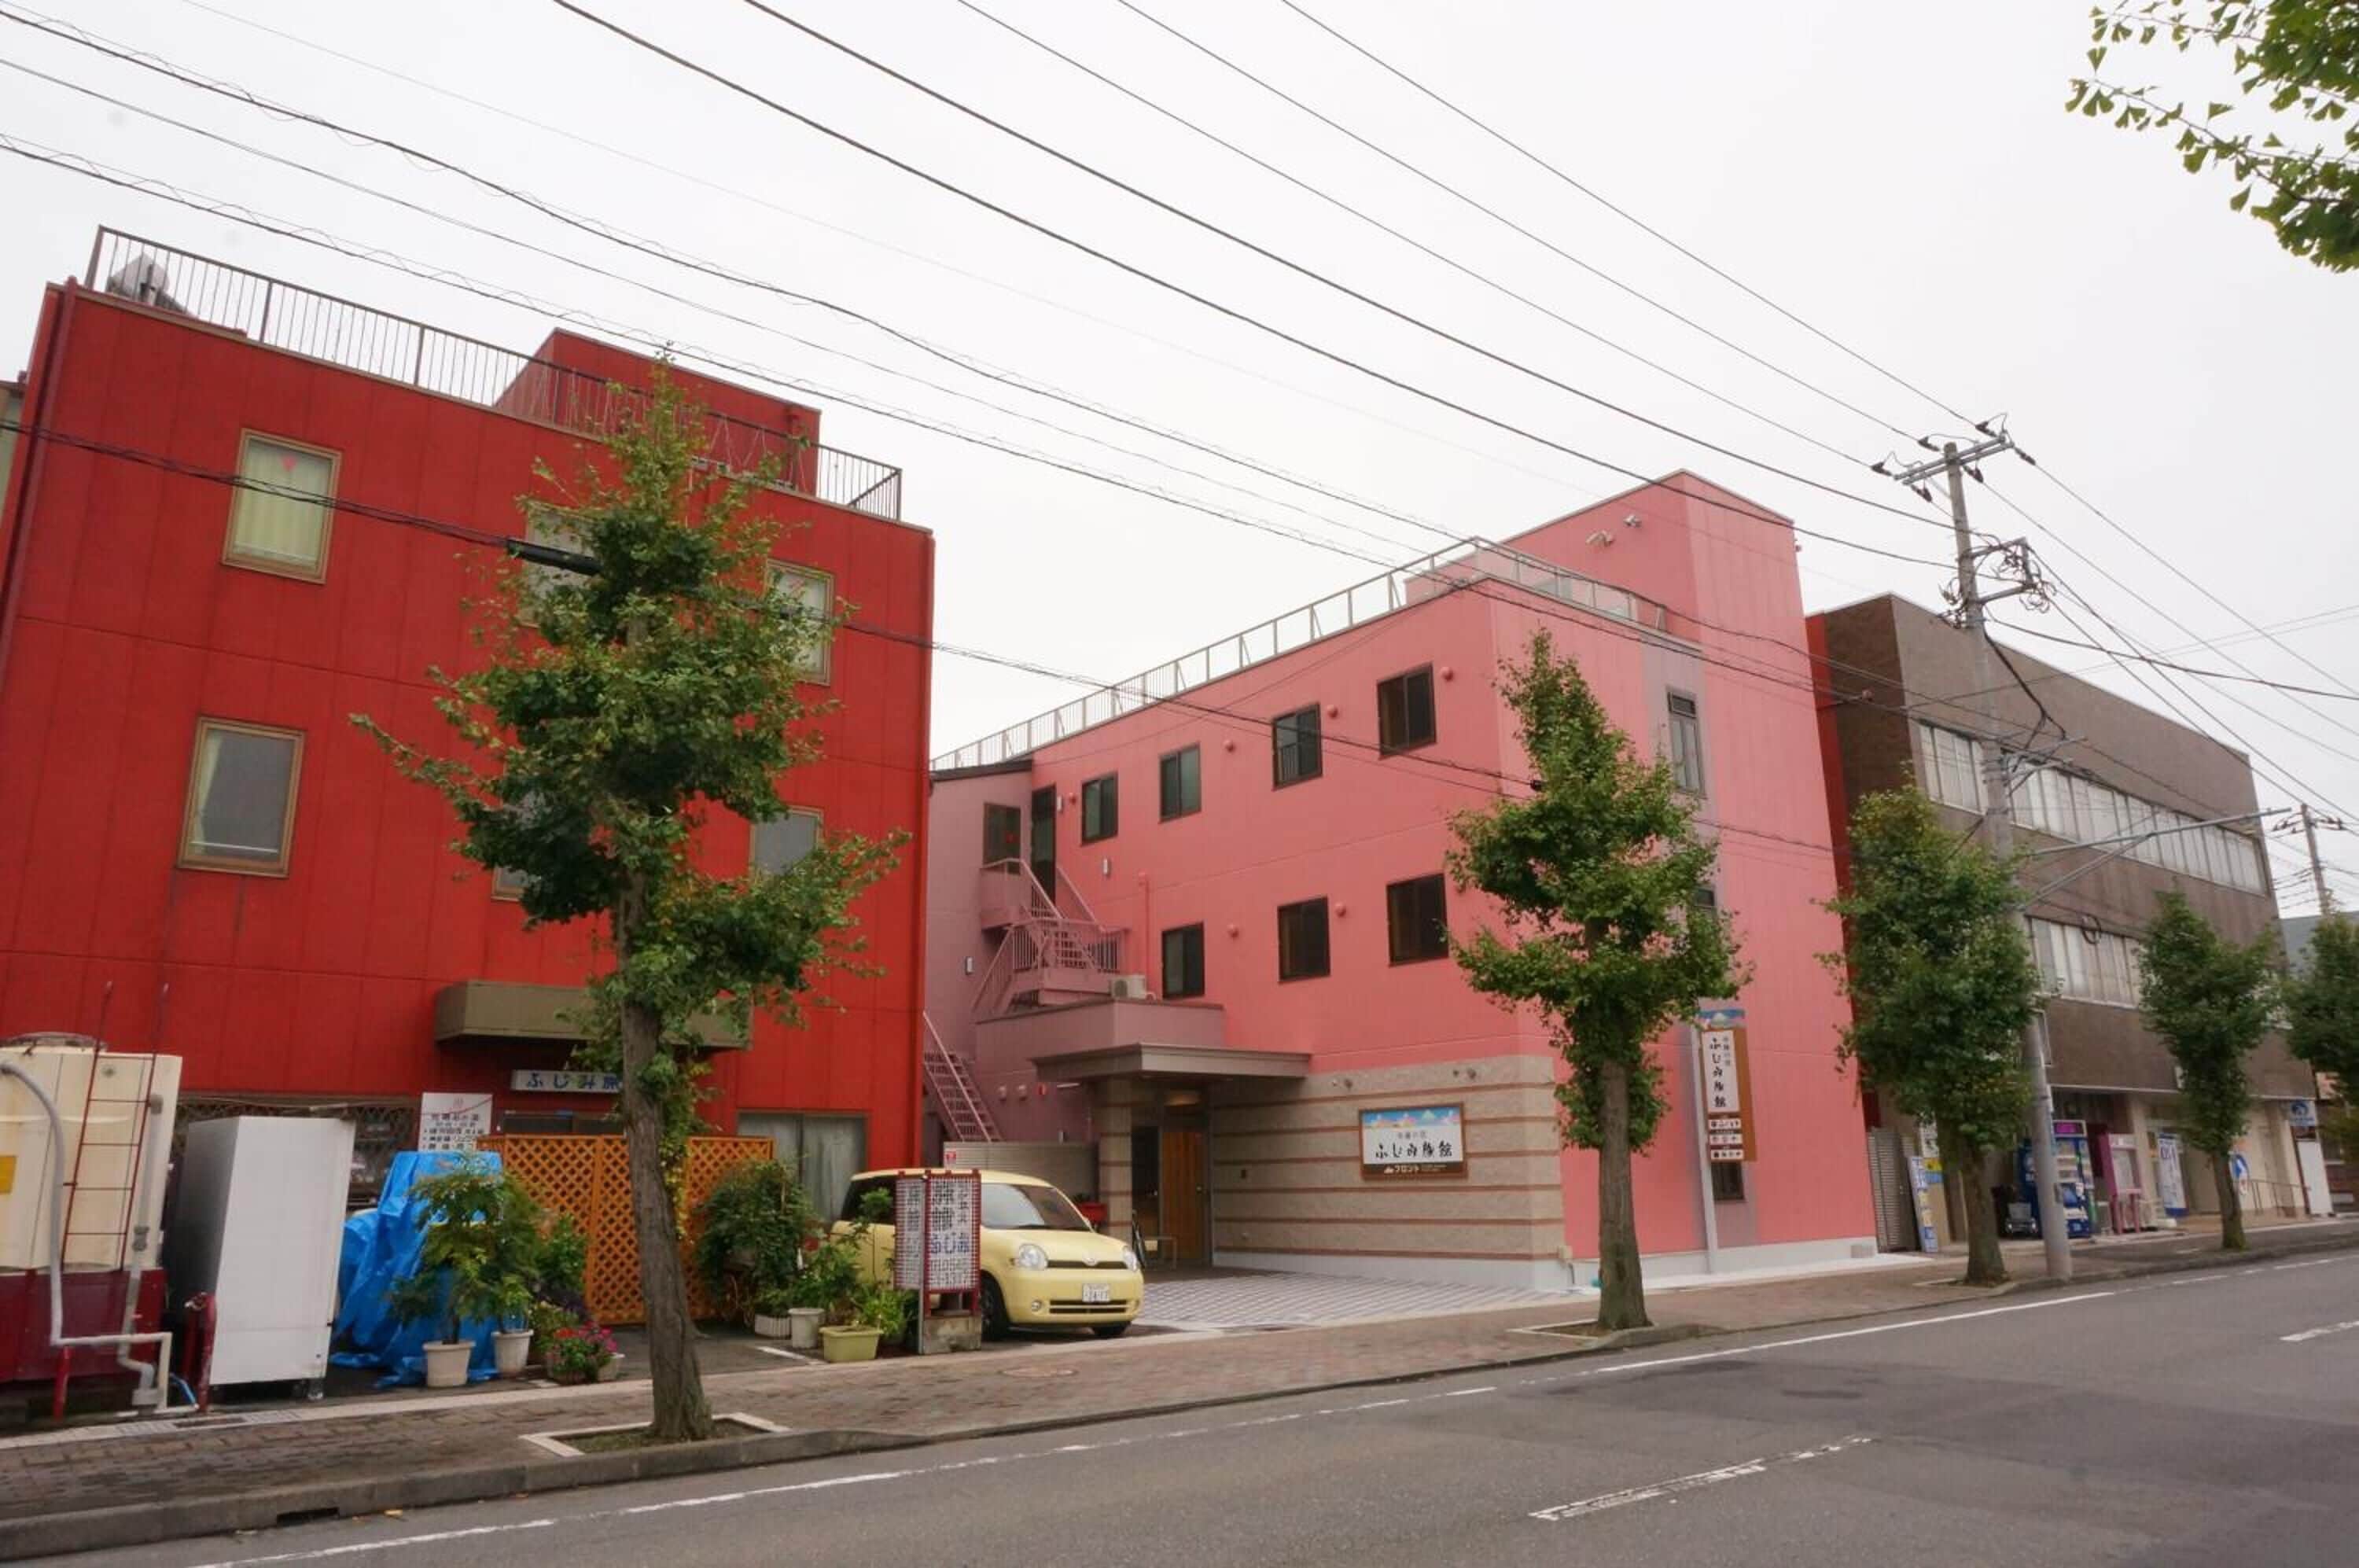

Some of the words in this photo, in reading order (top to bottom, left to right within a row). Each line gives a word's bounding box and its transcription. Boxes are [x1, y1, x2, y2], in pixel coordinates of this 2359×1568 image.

[527, 1072, 620, 1091] ふじみ旅
[1709, 1036, 1727, 1108] ふじみ旅館
[1375, 1139, 1453, 1159] ふじみ旅館
